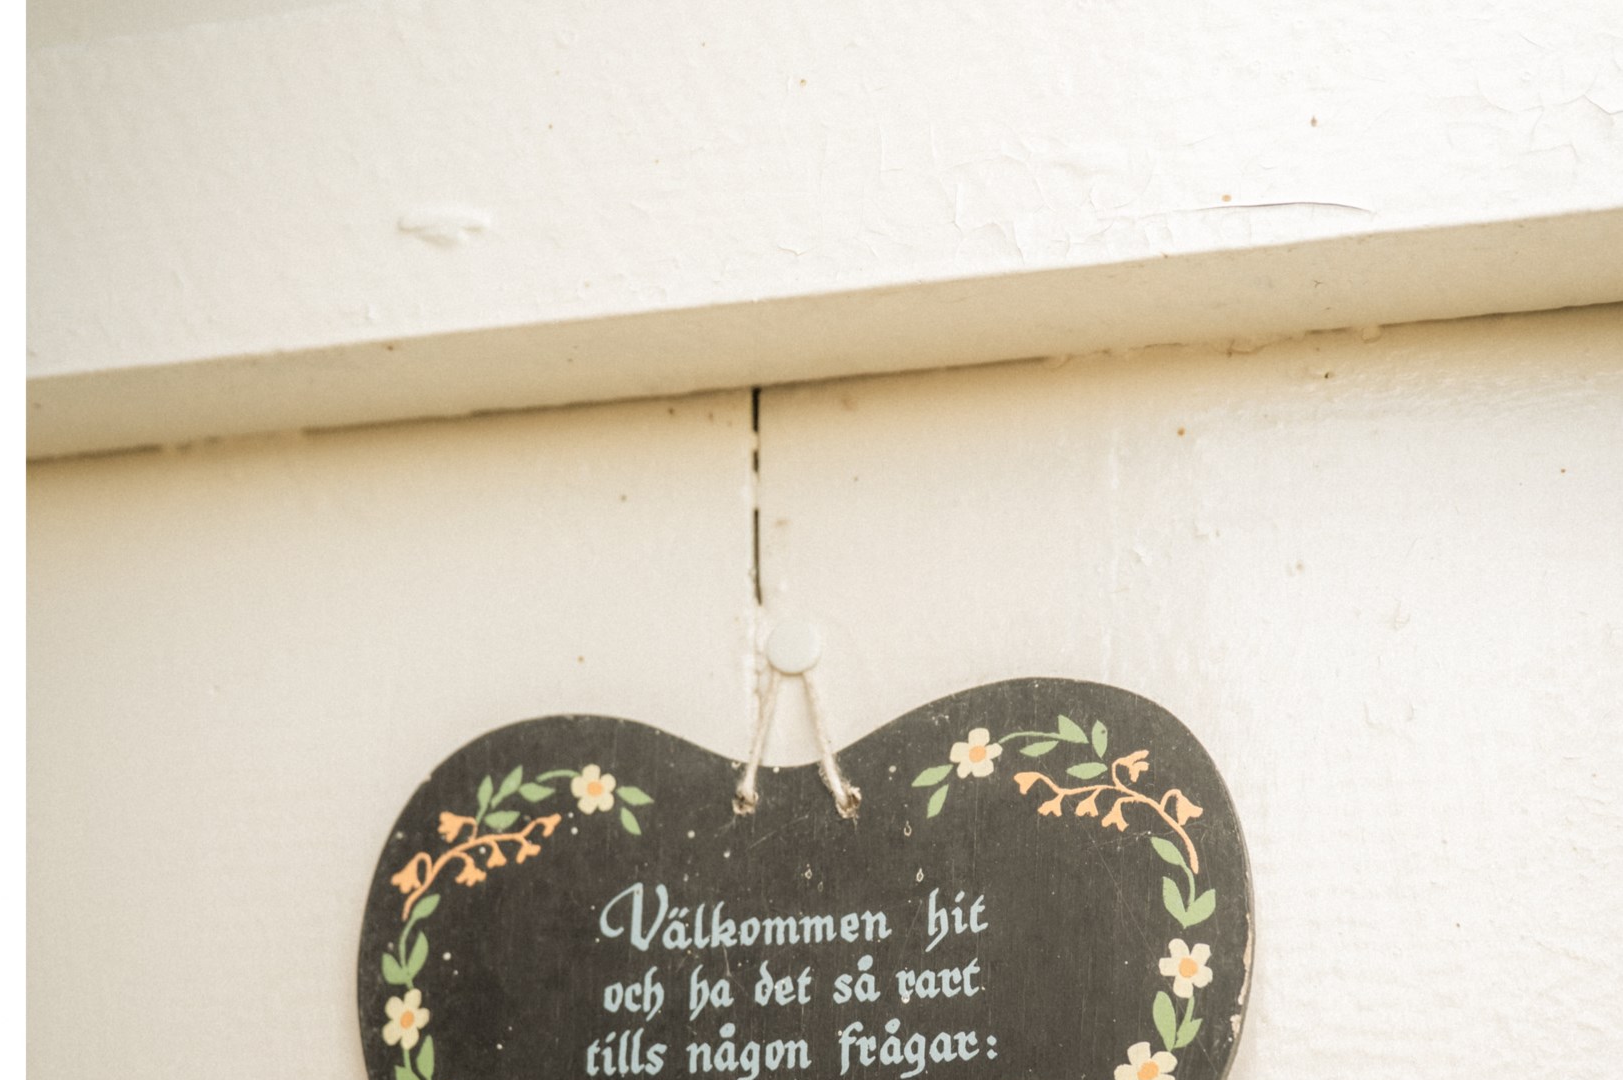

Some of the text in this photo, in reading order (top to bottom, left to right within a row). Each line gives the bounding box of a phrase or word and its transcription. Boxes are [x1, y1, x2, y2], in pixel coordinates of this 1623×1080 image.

[599, 881, 989, 953] Välkommen hit
[604, 965, 665, 1022] och
[689, 963, 735, 1022] ha
[754, 959, 813, 1007] det
[832, 953, 882, 1005] så
[586, 1027, 668, 1078] tills
[837, 1017, 999, 1080] frågar:
